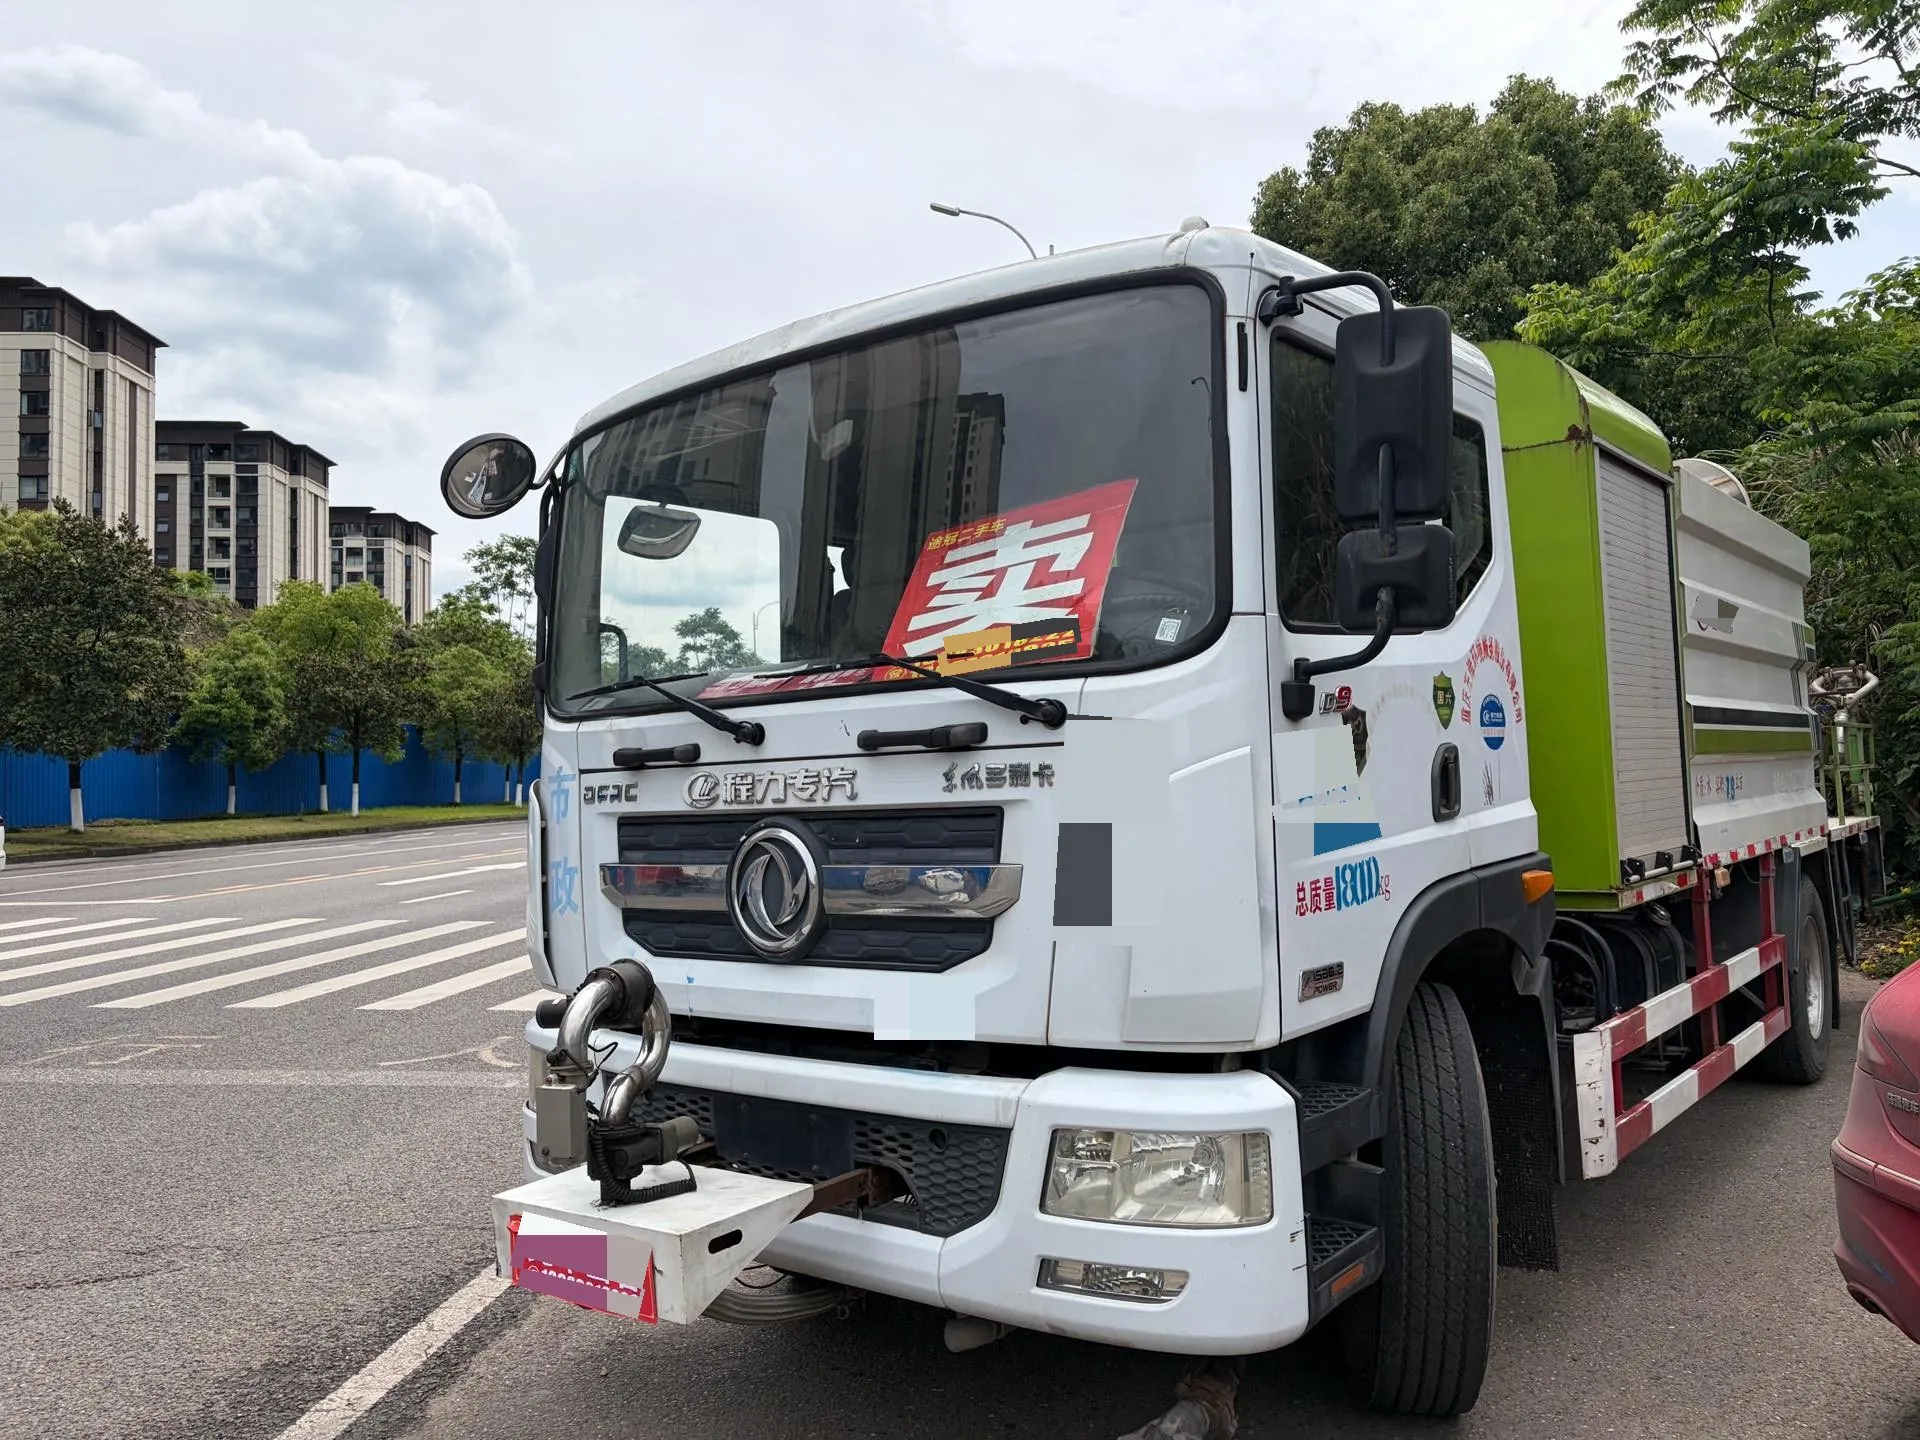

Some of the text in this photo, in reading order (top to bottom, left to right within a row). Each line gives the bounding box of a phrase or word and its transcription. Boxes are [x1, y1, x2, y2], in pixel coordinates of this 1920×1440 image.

[902, 513, 1094, 658] 卖
[1319, 685, 1352, 714] D9
[723, 767, 859, 805] 程力专汽
[548, 764, 579, 918] 市政
[1313, 981, 1338, 995] POWER
